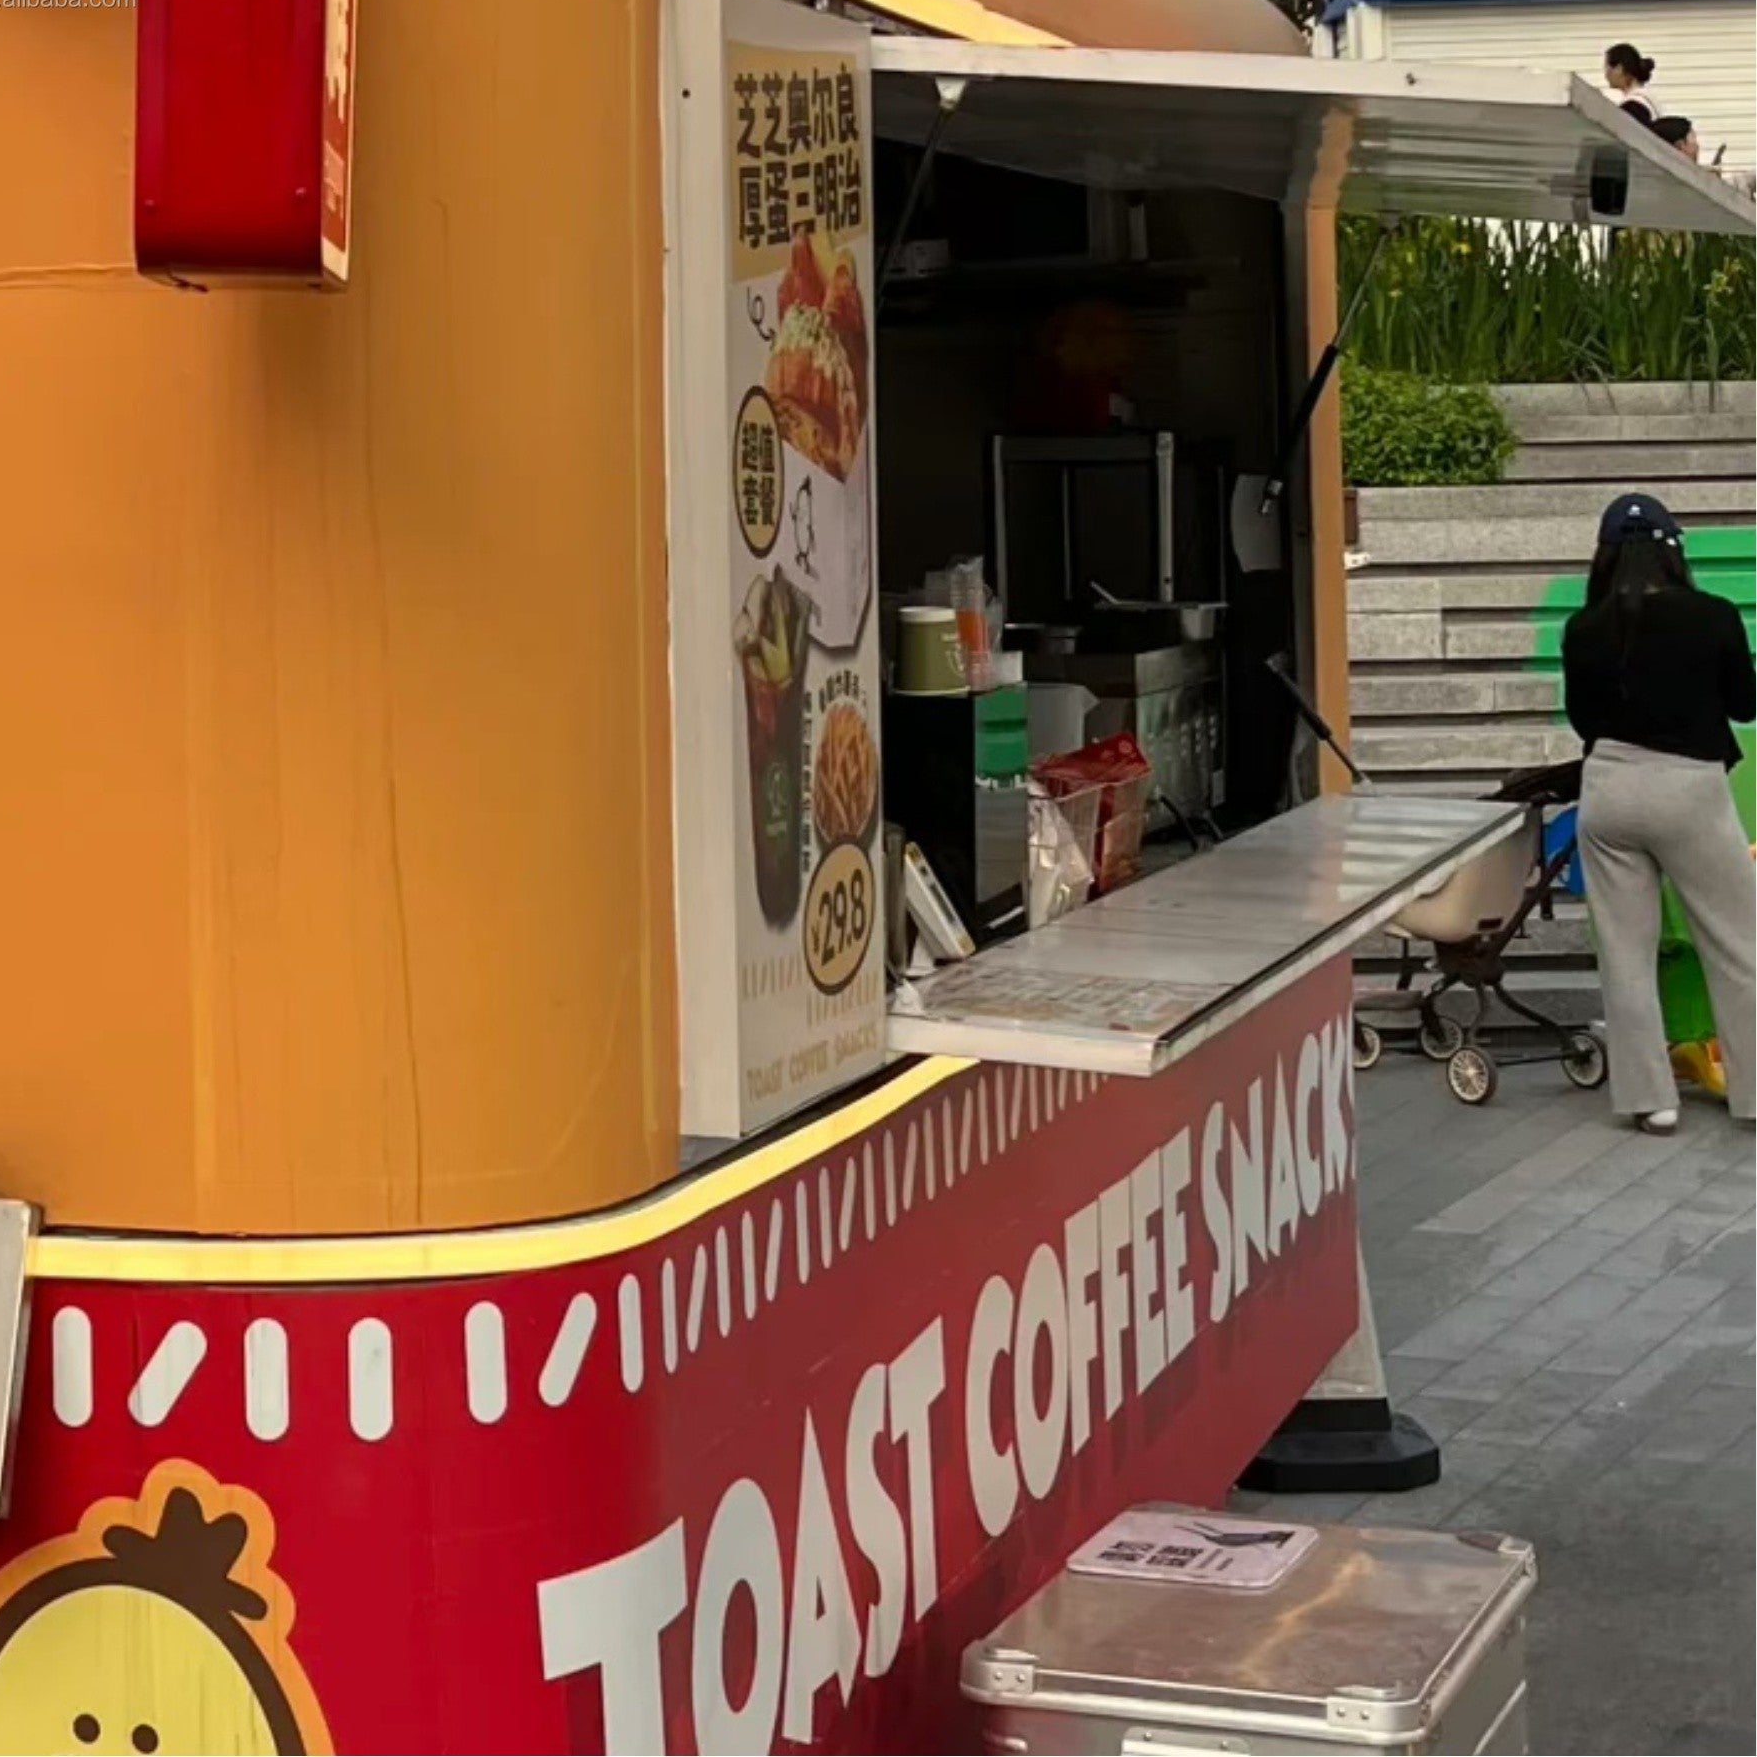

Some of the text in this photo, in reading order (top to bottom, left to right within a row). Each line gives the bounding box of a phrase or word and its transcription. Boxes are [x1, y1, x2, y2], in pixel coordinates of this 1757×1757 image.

[733, 61, 860, 159] 芝芝奥尔良
[738, 146, 862, 250] 厚蛋三明治
[536, 1315, 945, 1757] TOAST
[965, 1126, 1196, 1538] COFFEE
